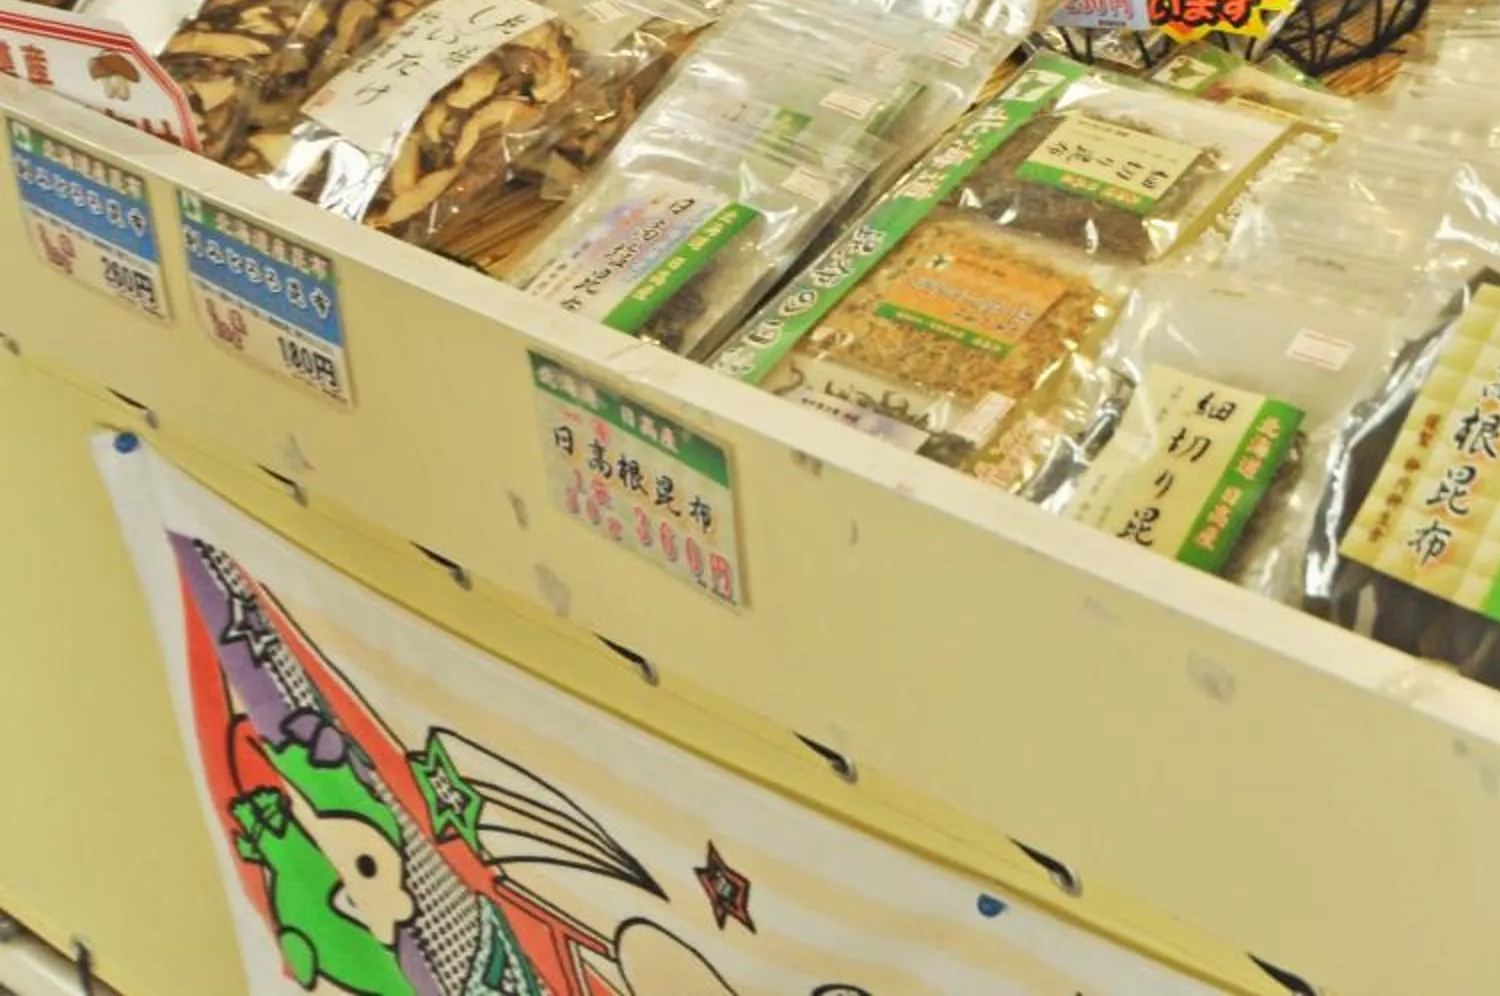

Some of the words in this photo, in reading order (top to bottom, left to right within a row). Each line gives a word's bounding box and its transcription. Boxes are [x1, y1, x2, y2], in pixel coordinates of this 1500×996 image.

[552, 424, 714, 536] 日高根昆布
